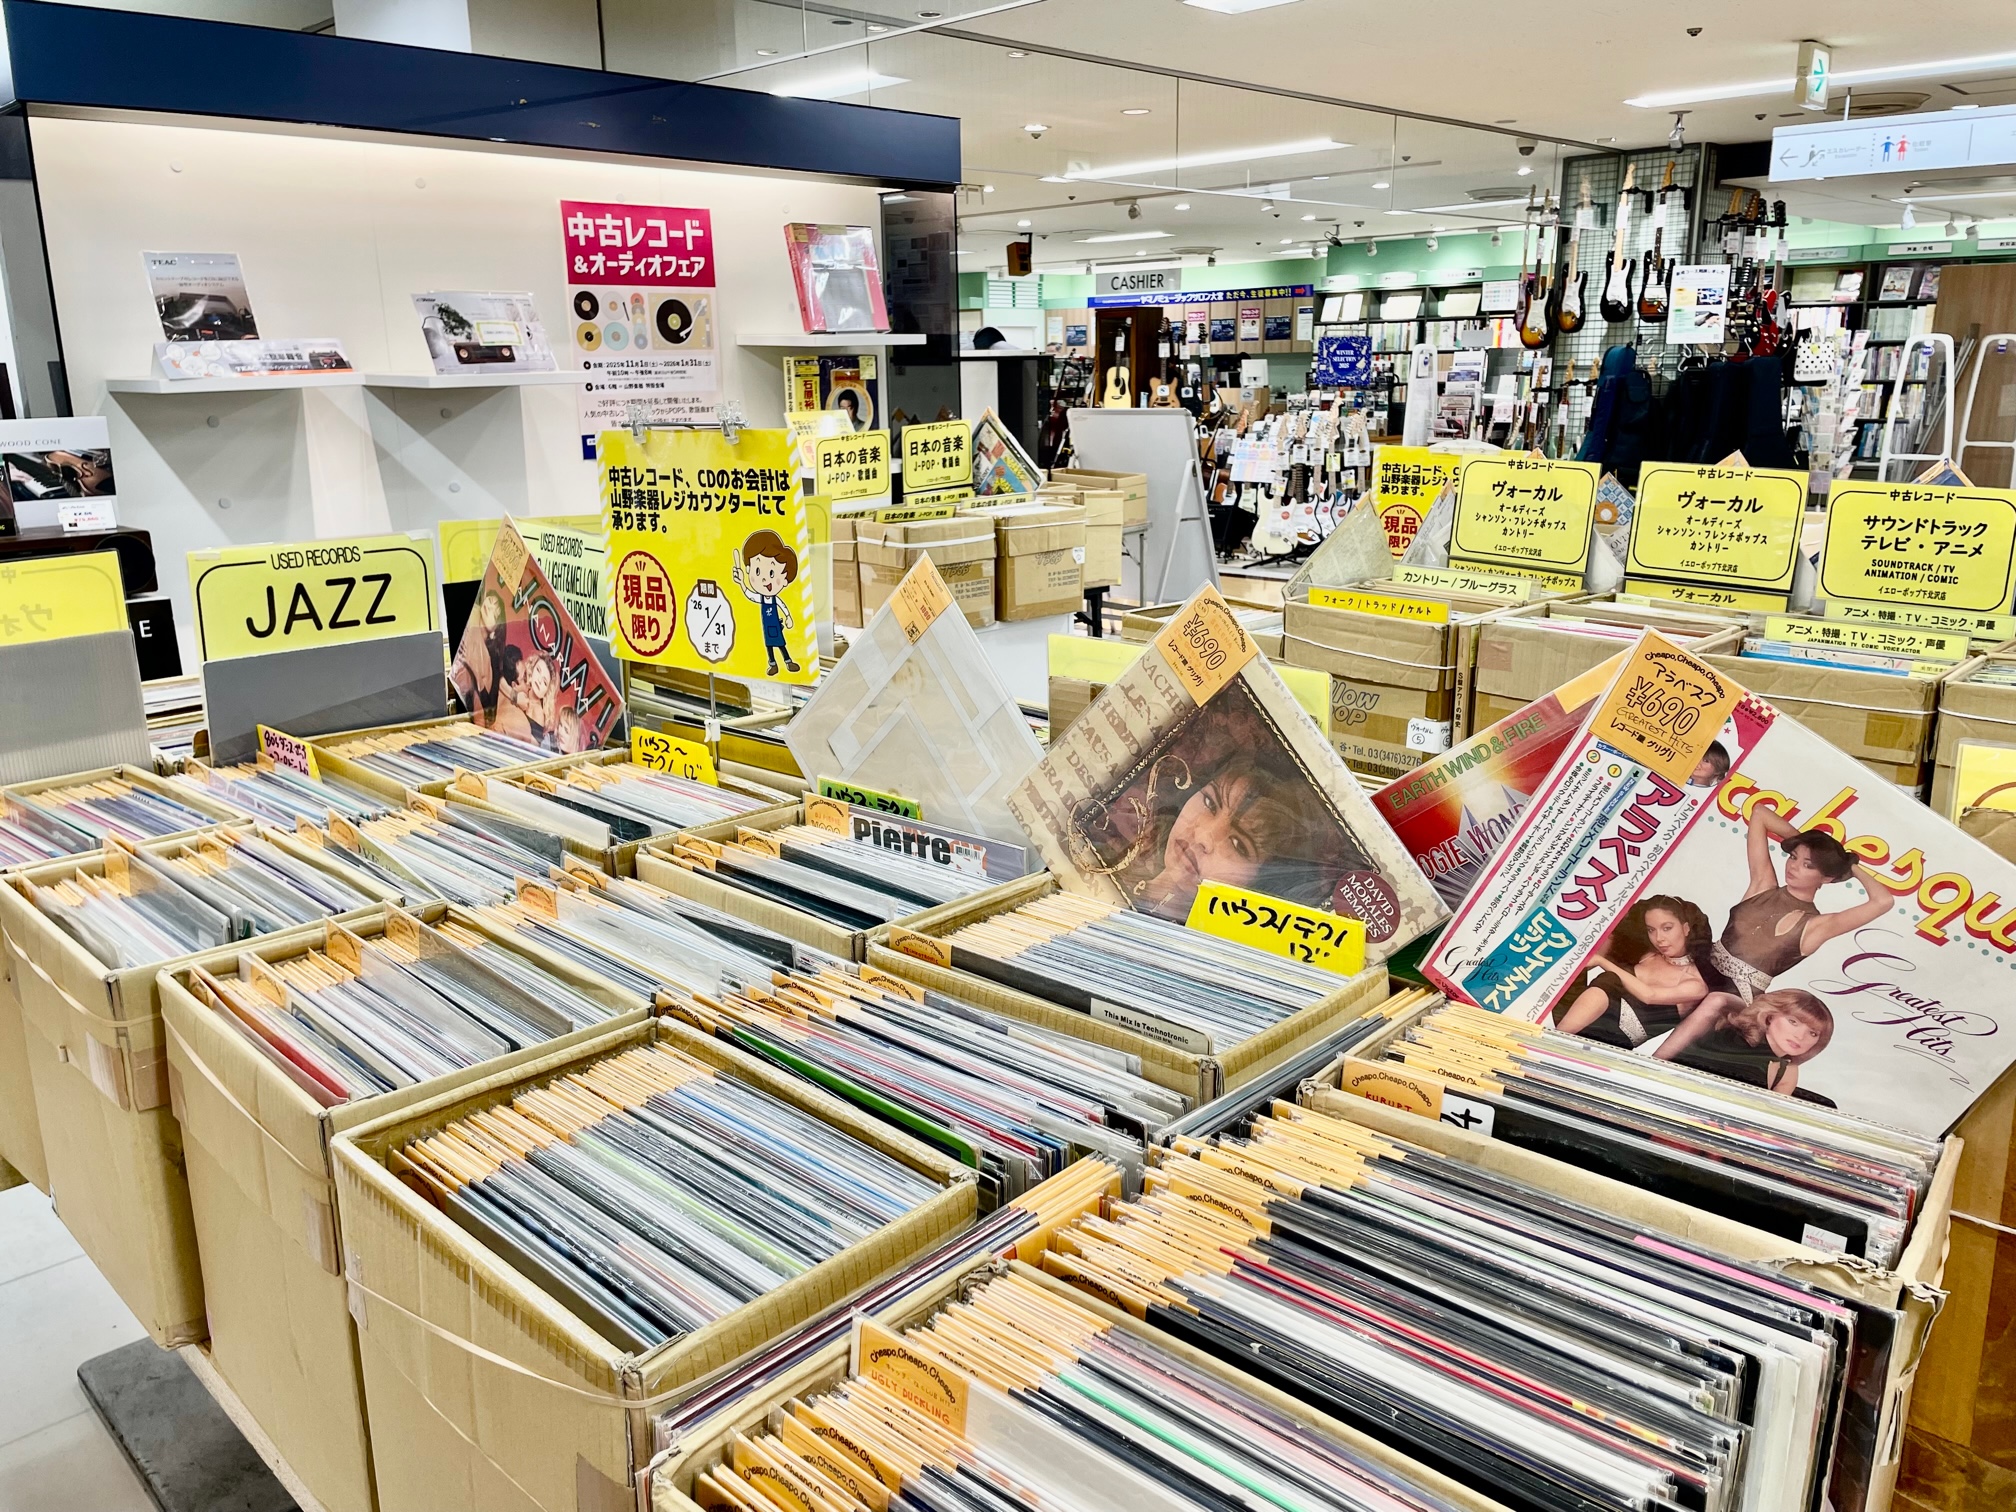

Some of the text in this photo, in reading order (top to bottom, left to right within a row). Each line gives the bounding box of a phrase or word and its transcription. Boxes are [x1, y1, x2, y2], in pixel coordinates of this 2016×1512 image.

[567, 212, 704, 251] 中古レコード
[574, 252, 706, 279] &オーディオフェア
[1111, 273, 1165, 291] CASHIER
[822, 446, 882, 469] 日本の音楽
[909, 435, 964, 456] 日本の音楽
[1508, 459, 1554, 472] 中古レコード
[1697, 467, 1754, 481] 中古レコード
[608, 465, 791, 494] 中古レコード、CDのお会計は
[1380, 485, 1424, 497] 承ります。
[1492, 480, 1563, 502] ヴォーカル
[609, 487, 786, 517] 山野楽器レジカウンターにて
[914, 496, 942, 505] 日本の音楽
[970, 499, 997, 509] 日本の音楽
[1677, 490, 1763, 514] ヴォーカル
[1890, 489, 1955, 503] 中古レコード
[611, 510, 669, 534] 承ります。
[884, 510, 916, 521] 日本の音楽
[1475, 511, 1566, 531] シャンソン・フレンチポップス
[1499, 503, 1546, 517] オールディーズ
[1686, 515, 1742, 529] オールディーズ
[1384, 516, 1418, 535] 現品
[1502, 528, 1534, 538] カントリー
[1657, 525, 1768, 545] シャンソン・フレンチポップス
[1863, 514, 1988, 538] サウンドトラック
[540, 533, 584, 558] USED RECORDS
[1389, 535, 1411, 549] 限り
[1689, 541, 1729, 552] カントリー
[1861, 535, 1984, 557] テレビ・アニメ
[271, 546, 361, 570] USED RECORDS
[1679, 559, 1738, 573] イエローポップ下北沢店
[1871, 559, 1933, 571] SOUNDTRACK
[1943, 563, 1955, 574] TV
[1403, 571, 1447, 588] カントリー
[1459, 577, 1517, 596] ブルーグラス
[1864, 569, 1917, 581] ANIMATION
[1926, 574, 1959, 585] COMIC
[622, 573, 667, 614] 現品
[1672, 588, 1737, 604] ヴォーカル
[1878, 585, 1947, 601] イエローポップ下北沢店
[246, 573, 396, 638] JAZZ
[1323, 595, 1432, 616] フォーク トラッド ケルト
[587, 603, 608, 637] ROCK
[631, 613, 661, 643] 限り
[517, 586, 589, 712] ANANARAMA
[703, 640, 720, 656] まで
[1183, 613, 1226, 671] ¥690
[1645, 651, 1725, 699] Cheapo,Cheapo,Cheapo
[1652, 661, 1717, 708] アラベスク
[1331, 679, 1380, 711] llow
[1625, 676, 1700, 736] ¥690
[1332, 705, 1367, 726] OP
[1368, 748, 1422, 767] 03(3476)3276
[1389, 711, 1548, 811] EARTH WIND & FIRE
[1646, 739, 1677, 762] グリグリ
[853, 816, 951, 865] Pierre
[1557, 771, 1686, 920] アラベスク
[1541, 813, 1610, 897] 恋にメリーゴーランド
[1347, 873, 1393, 935] MORALES
[1363, 876, 1396, 918] DAVID
[1339, 885, 1382, 939] REMIXES
[1509, 911, 1553, 953] ヒッツ
[1483, 932, 1573, 1010] グレイテスト
[1808, 928, 1998, 1037] Greatest
[1104, 1009, 1119, 1021] This
[1120, 1015, 1133, 1026] Mix
[1142, 1022, 1189, 1044] Technotronic
[1350, 1071, 1433, 1107] Cheapo,Cheapo,Cheapo
[870, 1347, 956, 1404] Cheapo,Cheapo,Cheapo
[871, 1369, 950, 1425] UGLY DUCKLING
